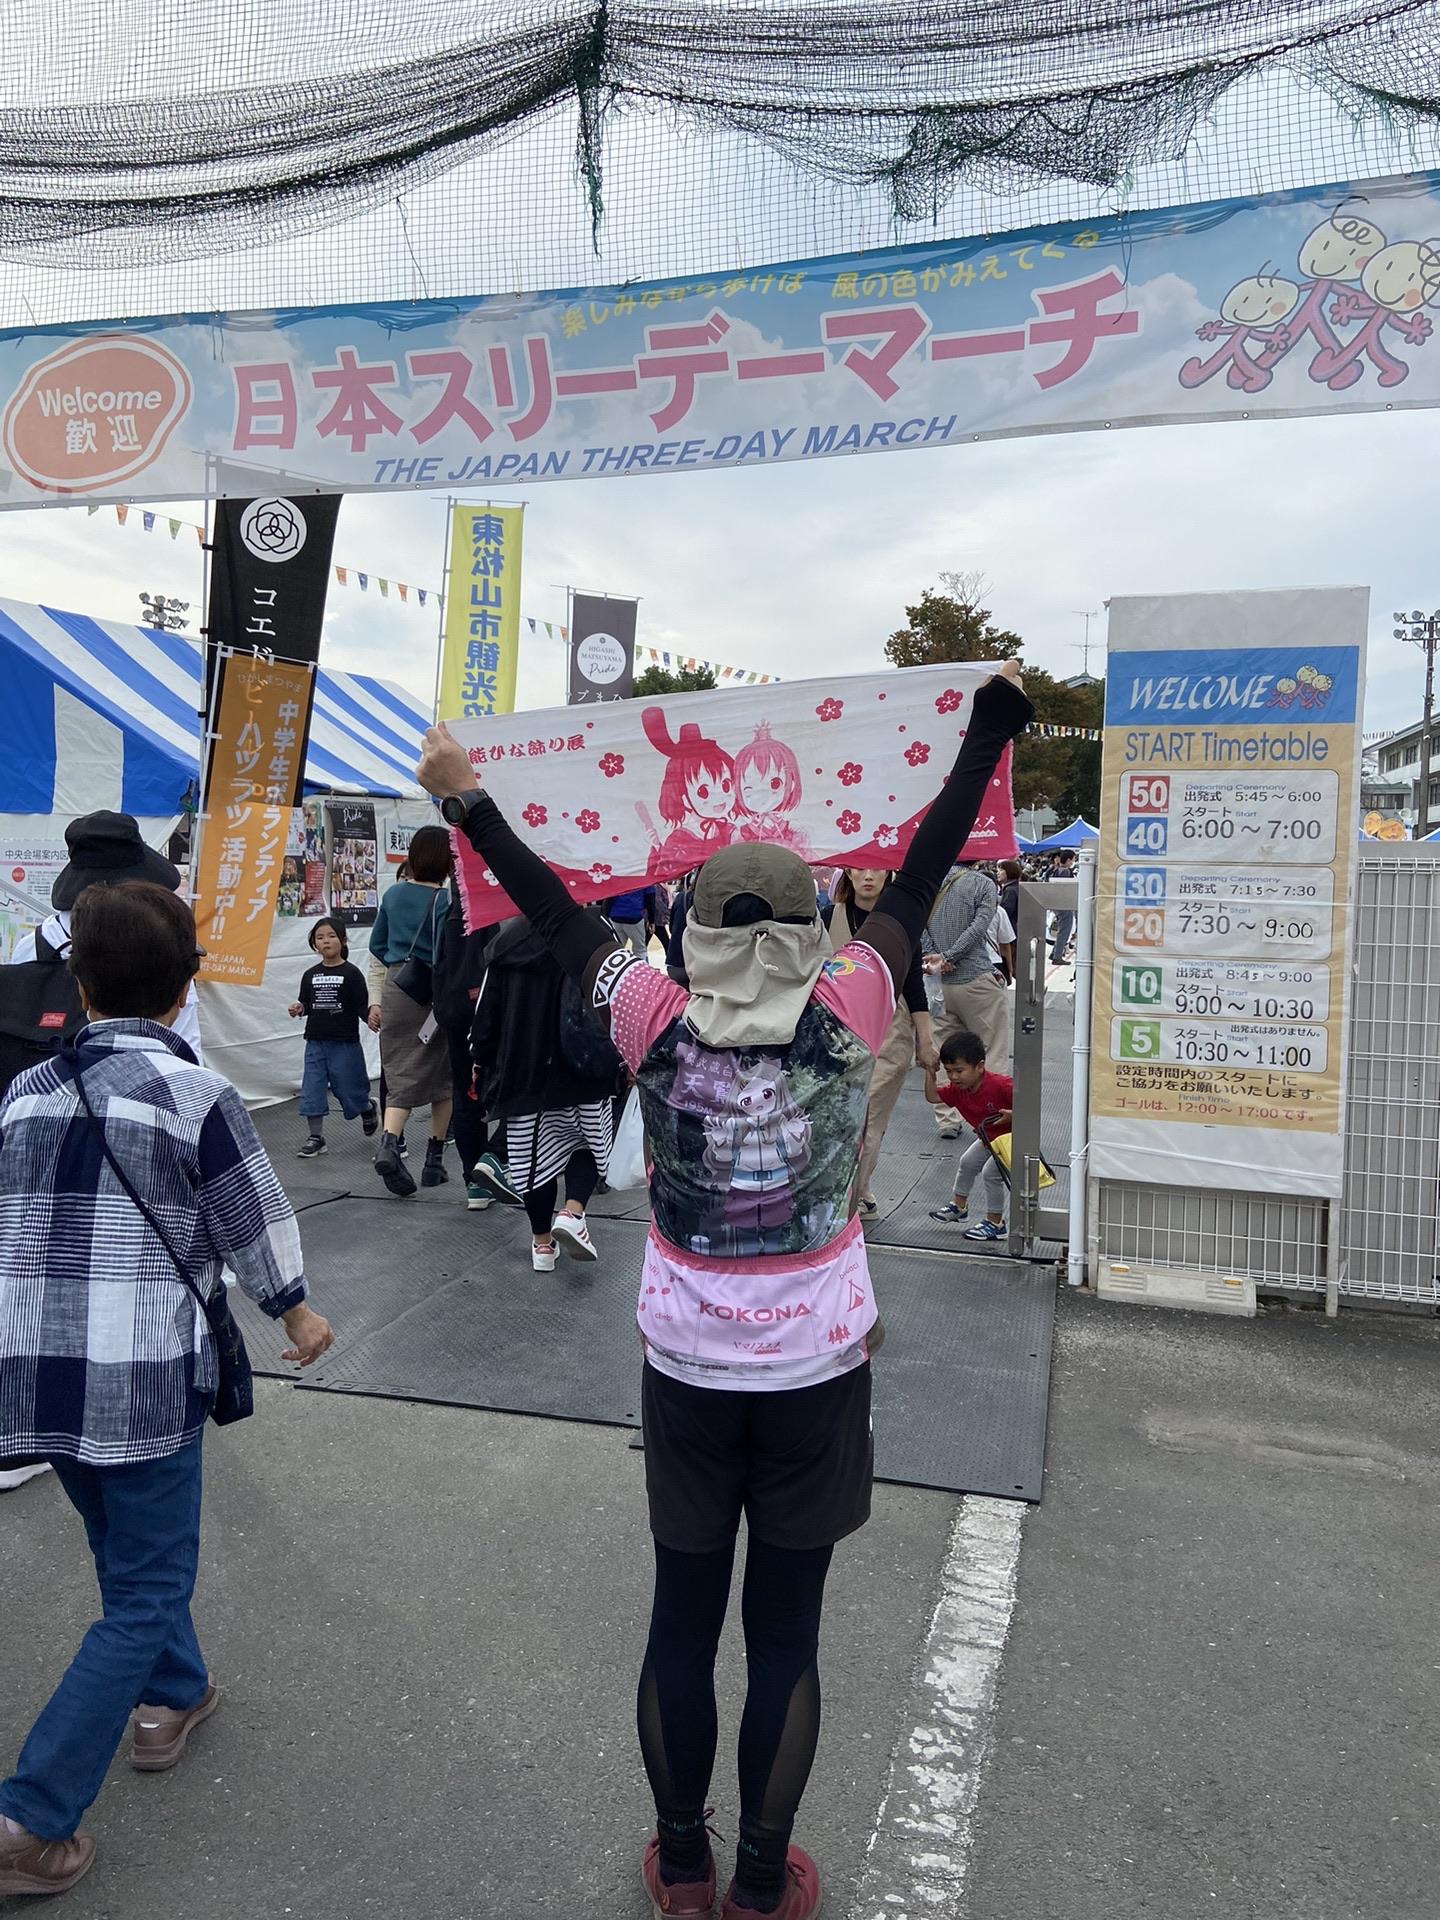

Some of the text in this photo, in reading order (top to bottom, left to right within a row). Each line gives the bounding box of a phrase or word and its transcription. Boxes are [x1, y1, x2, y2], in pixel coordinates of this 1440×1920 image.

[232, 271, 1139, 453] 日本スリーデーマーチ
[36, 385, 163, 417] Welcome
[373, 414, 958, 485] THE JAPAN THREE-DAY MARCH
[581, 652, 623, 663] MATSUYAMA
[589, 662, 618, 676] Pride
[1128, 675, 1275, 711] WELCOME
[1125, 731, 1329, 762] START Timetable
[1131, 780, 1168, 808] 50
[1184, 791, 1222, 802] 出発式
[1235, 784, 1287, 792] Ceremony
[1182, 806, 1232, 818] スタート
[1128, 822, 1165, 850] 40
[1126, 873, 1164, 901] 30
[1179, 883, 1217, 895] 出発式
[1179, 902, 1228, 913] スタート
[1126, 913, 1162, 942] 20
[1125, 971, 1158, 999] 10
[1176, 968, 1214, 980] 出発式
[1176, 983, 1225, 996] スタート
[1131, 1026, 1152, 1054] 5
[1174, 1028, 1223, 1040] スタート
[1116, 1064, 1297, 1087] 設定時間内のスタートに
[1116, 1076, 1323, 1101] ご協力をお願いいたします。
[699, 1300, 812, 1323] KOKONA
